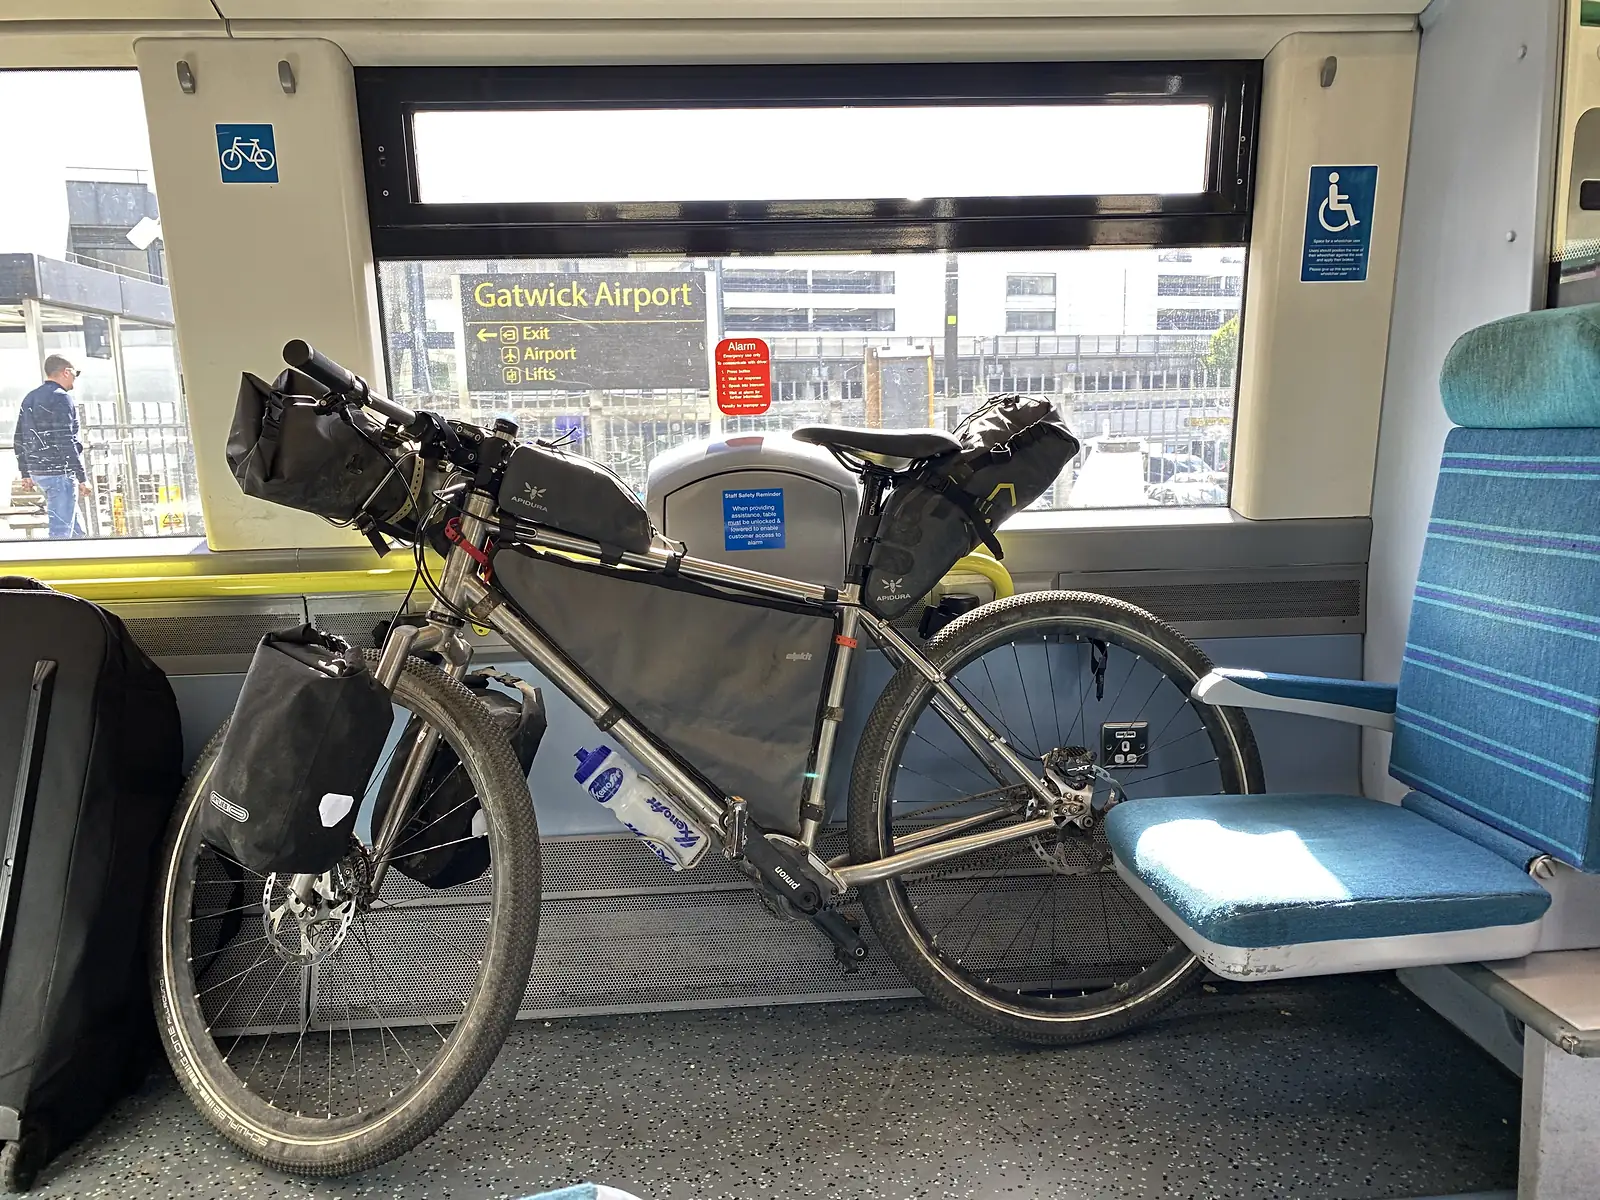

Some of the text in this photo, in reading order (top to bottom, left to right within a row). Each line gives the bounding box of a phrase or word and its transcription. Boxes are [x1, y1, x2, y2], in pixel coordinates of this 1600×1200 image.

[474, 281, 692, 312] Gatwick Airport
[523, 327, 550, 340] Exit
[728, 342, 756, 351] Alarm
[524, 347, 576, 362] Airport
[526, 368, 556, 381] Lifts
[511, 496, 548, 512] APIDURA
[876, 594, 911, 602] APIDURA
[646, 796, 700, 848] Xenofit
[774, 866, 800, 890] pinion
[160, 979, 268, 1147] SCHWALBE G-ONE ALLROUND
